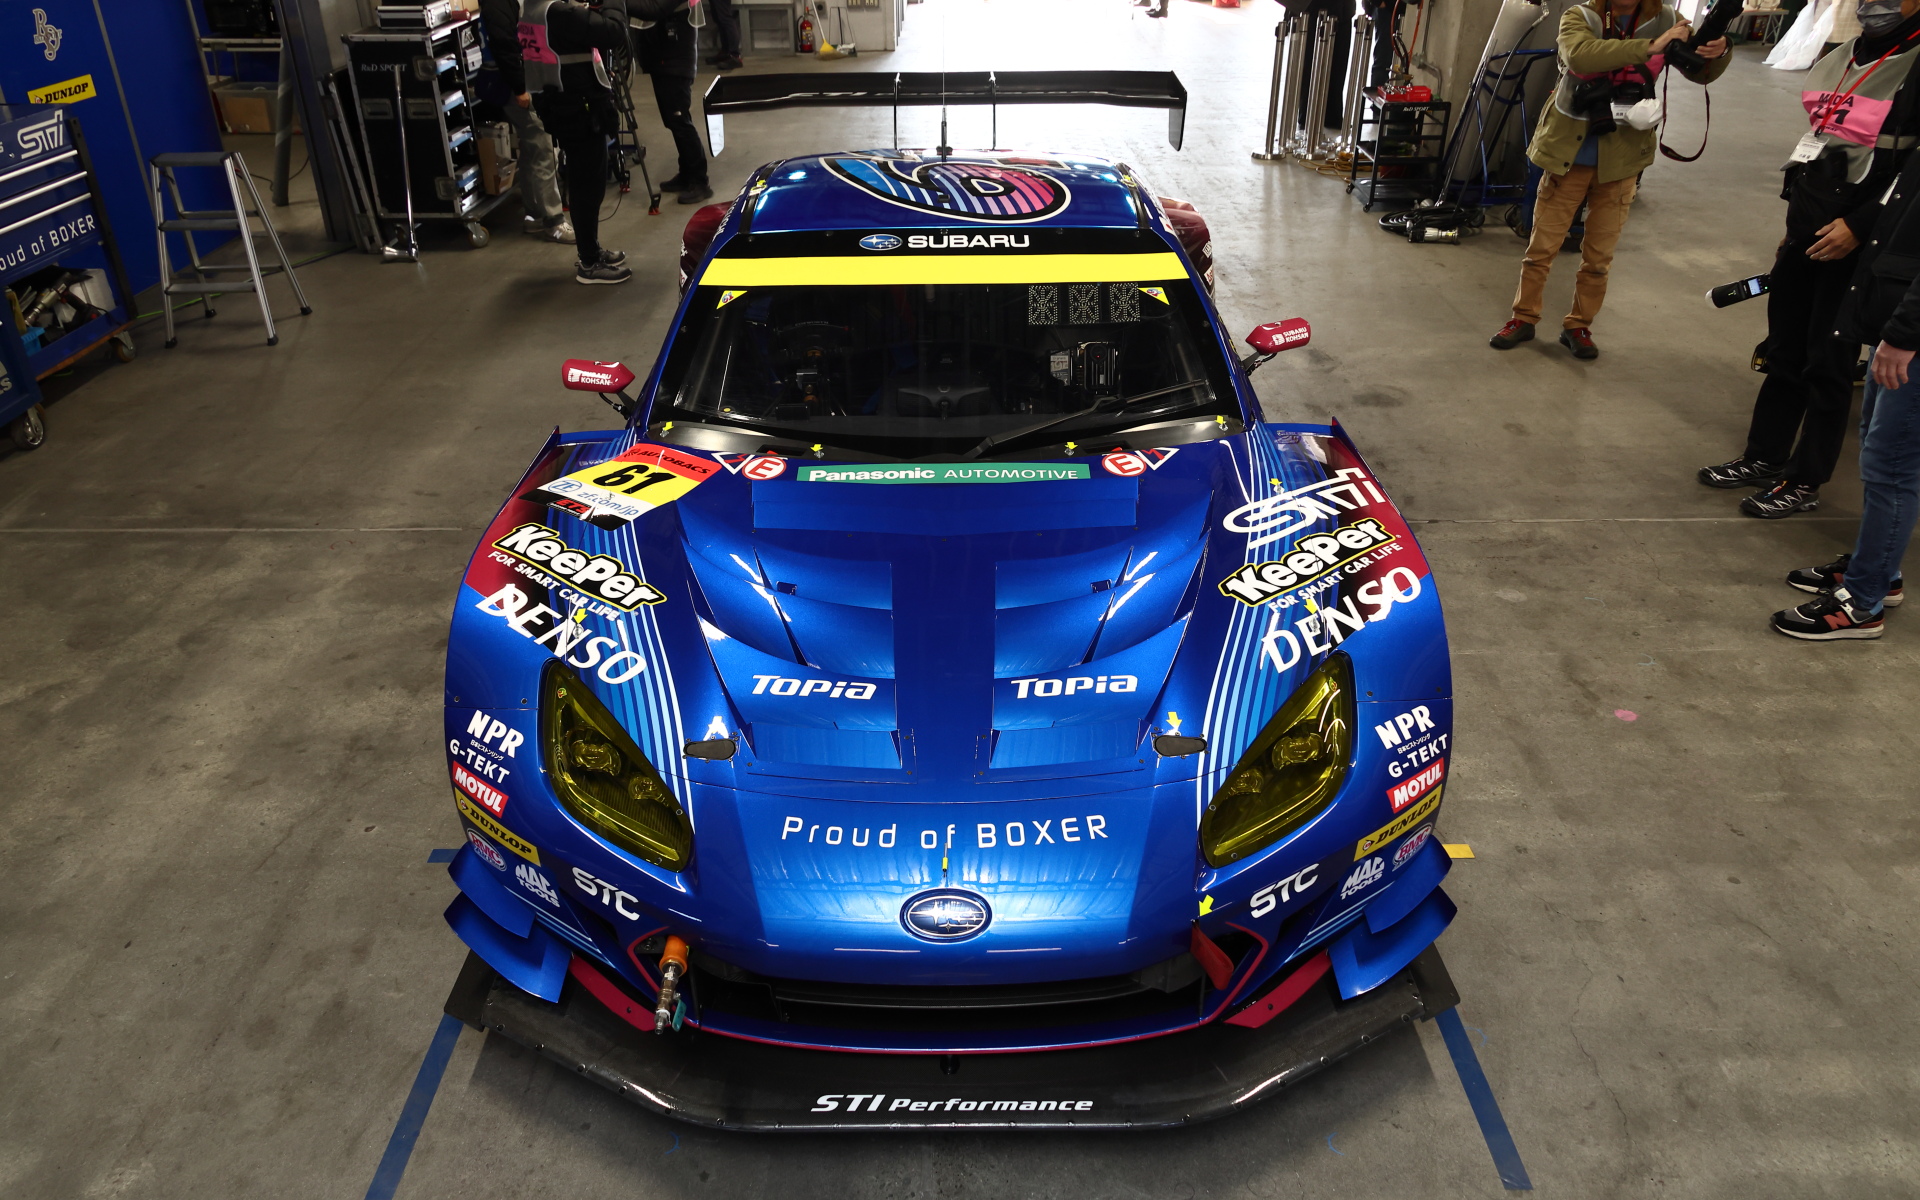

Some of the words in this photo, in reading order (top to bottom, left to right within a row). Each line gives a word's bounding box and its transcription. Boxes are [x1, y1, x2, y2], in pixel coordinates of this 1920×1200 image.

[379, 63, 408, 72] SPOT
[44, 82, 89, 104] DUNLOP
[1818, 92, 1854, 107] MDA
[1812, 104, 1850, 125] 21
[31, 235, 46, 256] of
[49, 213, 96, 248] BOXER
[907, 234, 1030, 248] SUBARU
[1283, 327, 1308, 337] SUBARU
[1285, 332, 1309, 343] KOHSAN
[580, 376, 611, 386] KOHSAN
[592, 464, 677, 495] 61
[638, 450, 711, 474] AUTOBACS
[808, 467, 936, 482] Panasonic
[943, 468, 1079, 480] AUTOMOTIVE
[551, 480, 575, 493] ZF
[577, 492, 640, 516] zf.com/jp
[488, 551, 516, 567] FOR
[514, 563, 561, 590] SMART
[559, 588, 590, 608] CAR
[587, 601, 622, 622] LIFE
[1267, 595, 1300, 614] FOR
[1297, 573, 1345, 600] SMART
[1344, 557, 1374, 574] CAR
[1371, 542, 1404, 560] LIFE
[475, 583, 648, 685] DENSO
[1260, 566, 1422, 674] DENSO
[466, 709, 525, 759] NPR
[1374, 705, 1436, 750] NPR
[449, 738, 510, 784] G-TEKT
[1388, 733, 1448, 779] G-TEKT
[455, 766, 504, 813] MOTUL
[1393, 763, 1442, 809] MOTUL
[469, 805, 533, 854] DUNLOP
[781, 815, 897, 848] Proud
[920, 823, 957, 850] of
[976, 814, 1110, 848] BOXER
[1375, 794, 1438, 845] DUNLOP
[515, 864, 559, 900] MAC
[516, 876, 561, 908] TOOLS
[1249, 863, 1320, 919] STC
[1340, 871, 1383, 900] TOOLS
[1341, 856, 1385, 893] MAC
[572, 866, 640, 921] STC
[810, 1094, 886, 1112] STI
[887, 1097, 1094, 1112] Performance
